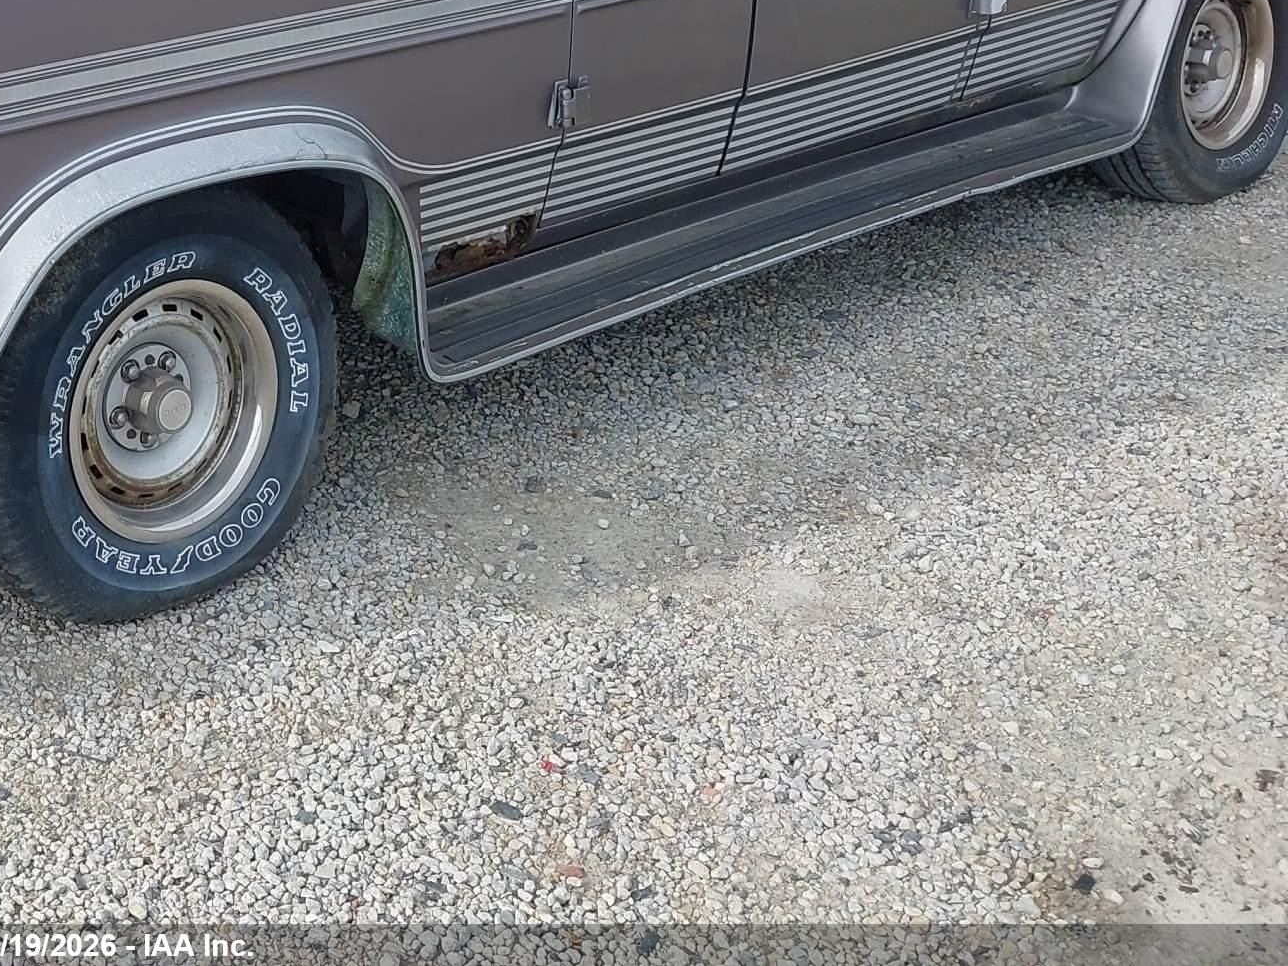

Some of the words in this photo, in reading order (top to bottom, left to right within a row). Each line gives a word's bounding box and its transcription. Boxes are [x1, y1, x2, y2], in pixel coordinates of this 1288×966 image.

[1215, 102, 1284, 172] MICHELIN
[48, 250, 197, 459] WRANGLER
[243, 267, 310, 414] RADIAL
[70, 477, 282, 576] GOODYEAR
